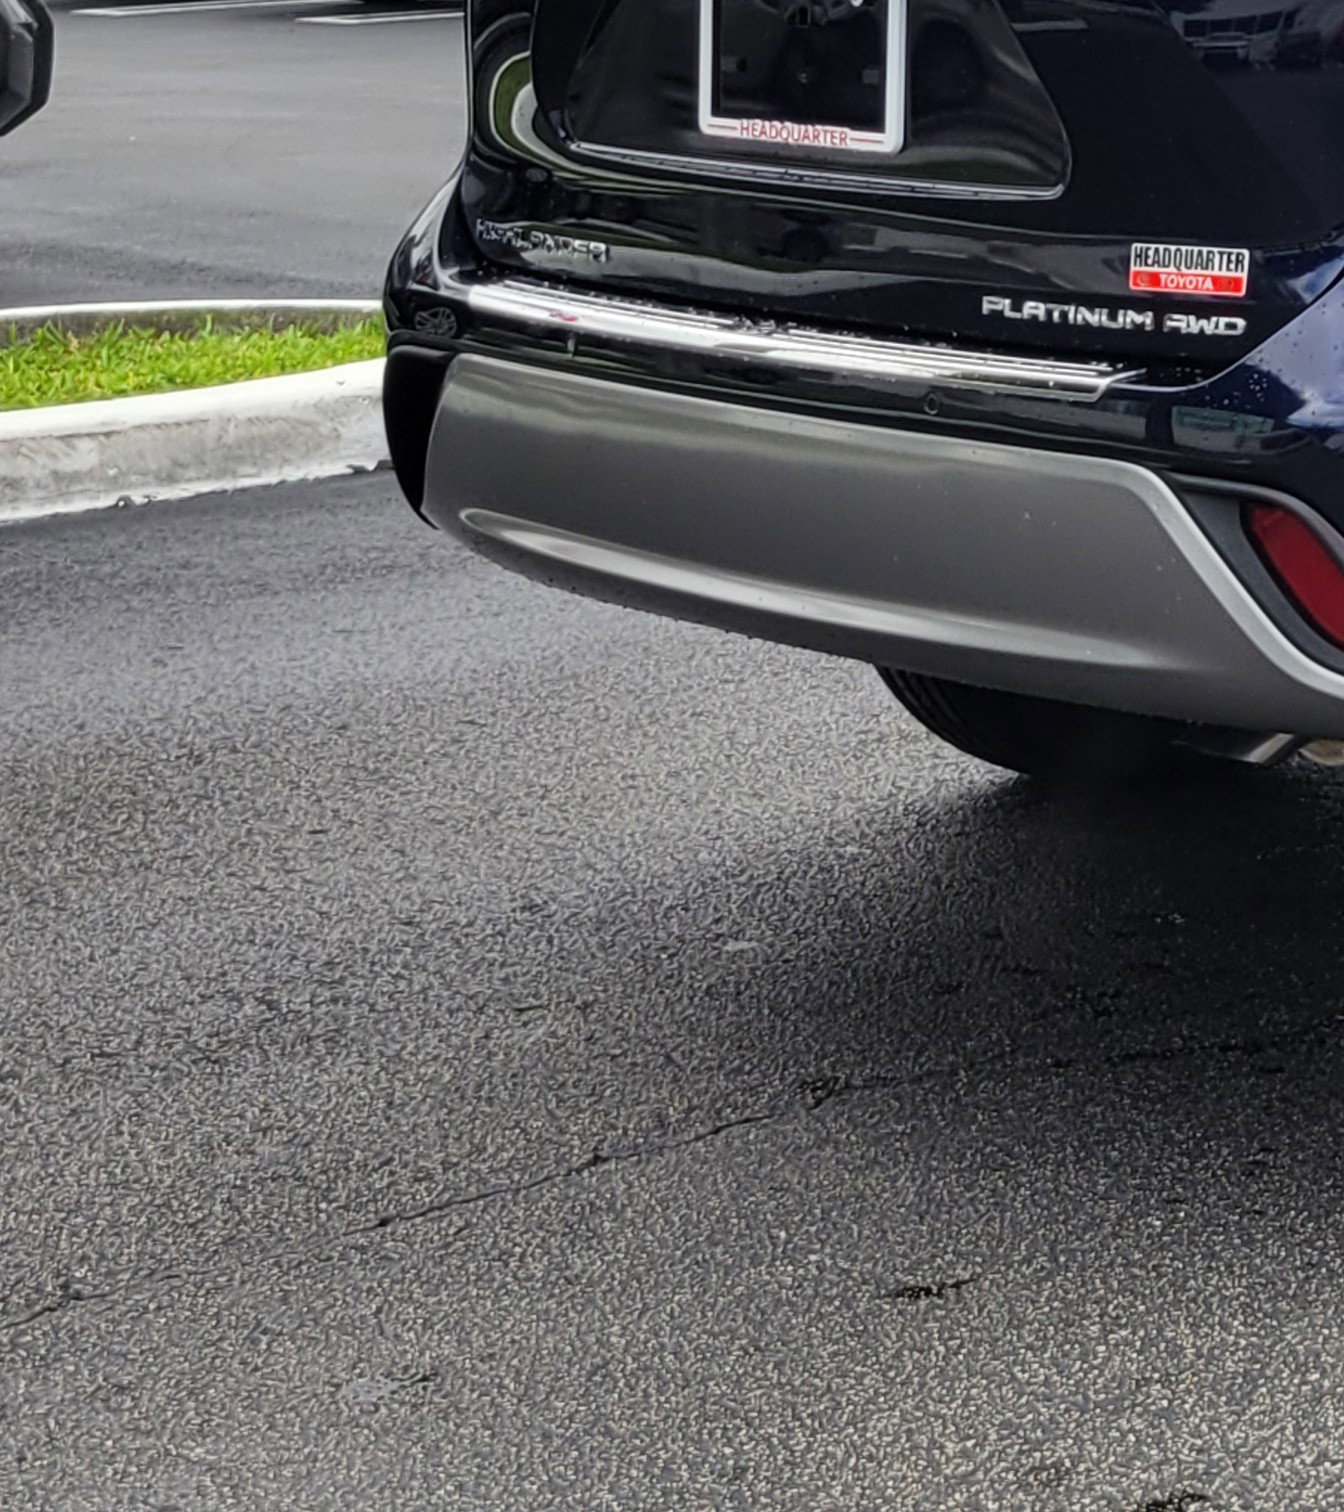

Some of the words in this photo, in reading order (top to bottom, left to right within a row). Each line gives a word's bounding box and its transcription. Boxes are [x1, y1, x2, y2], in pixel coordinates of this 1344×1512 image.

[740, 122, 848, 146] HEADQUARTER
[1133, 247, 1245, 273] HEADQUARTER
[1159, 275, 1214, 290] TOYOTA
[982, 296, 1154, 331] PLATINUM
[1163, 314, 1247, 336] AWD
